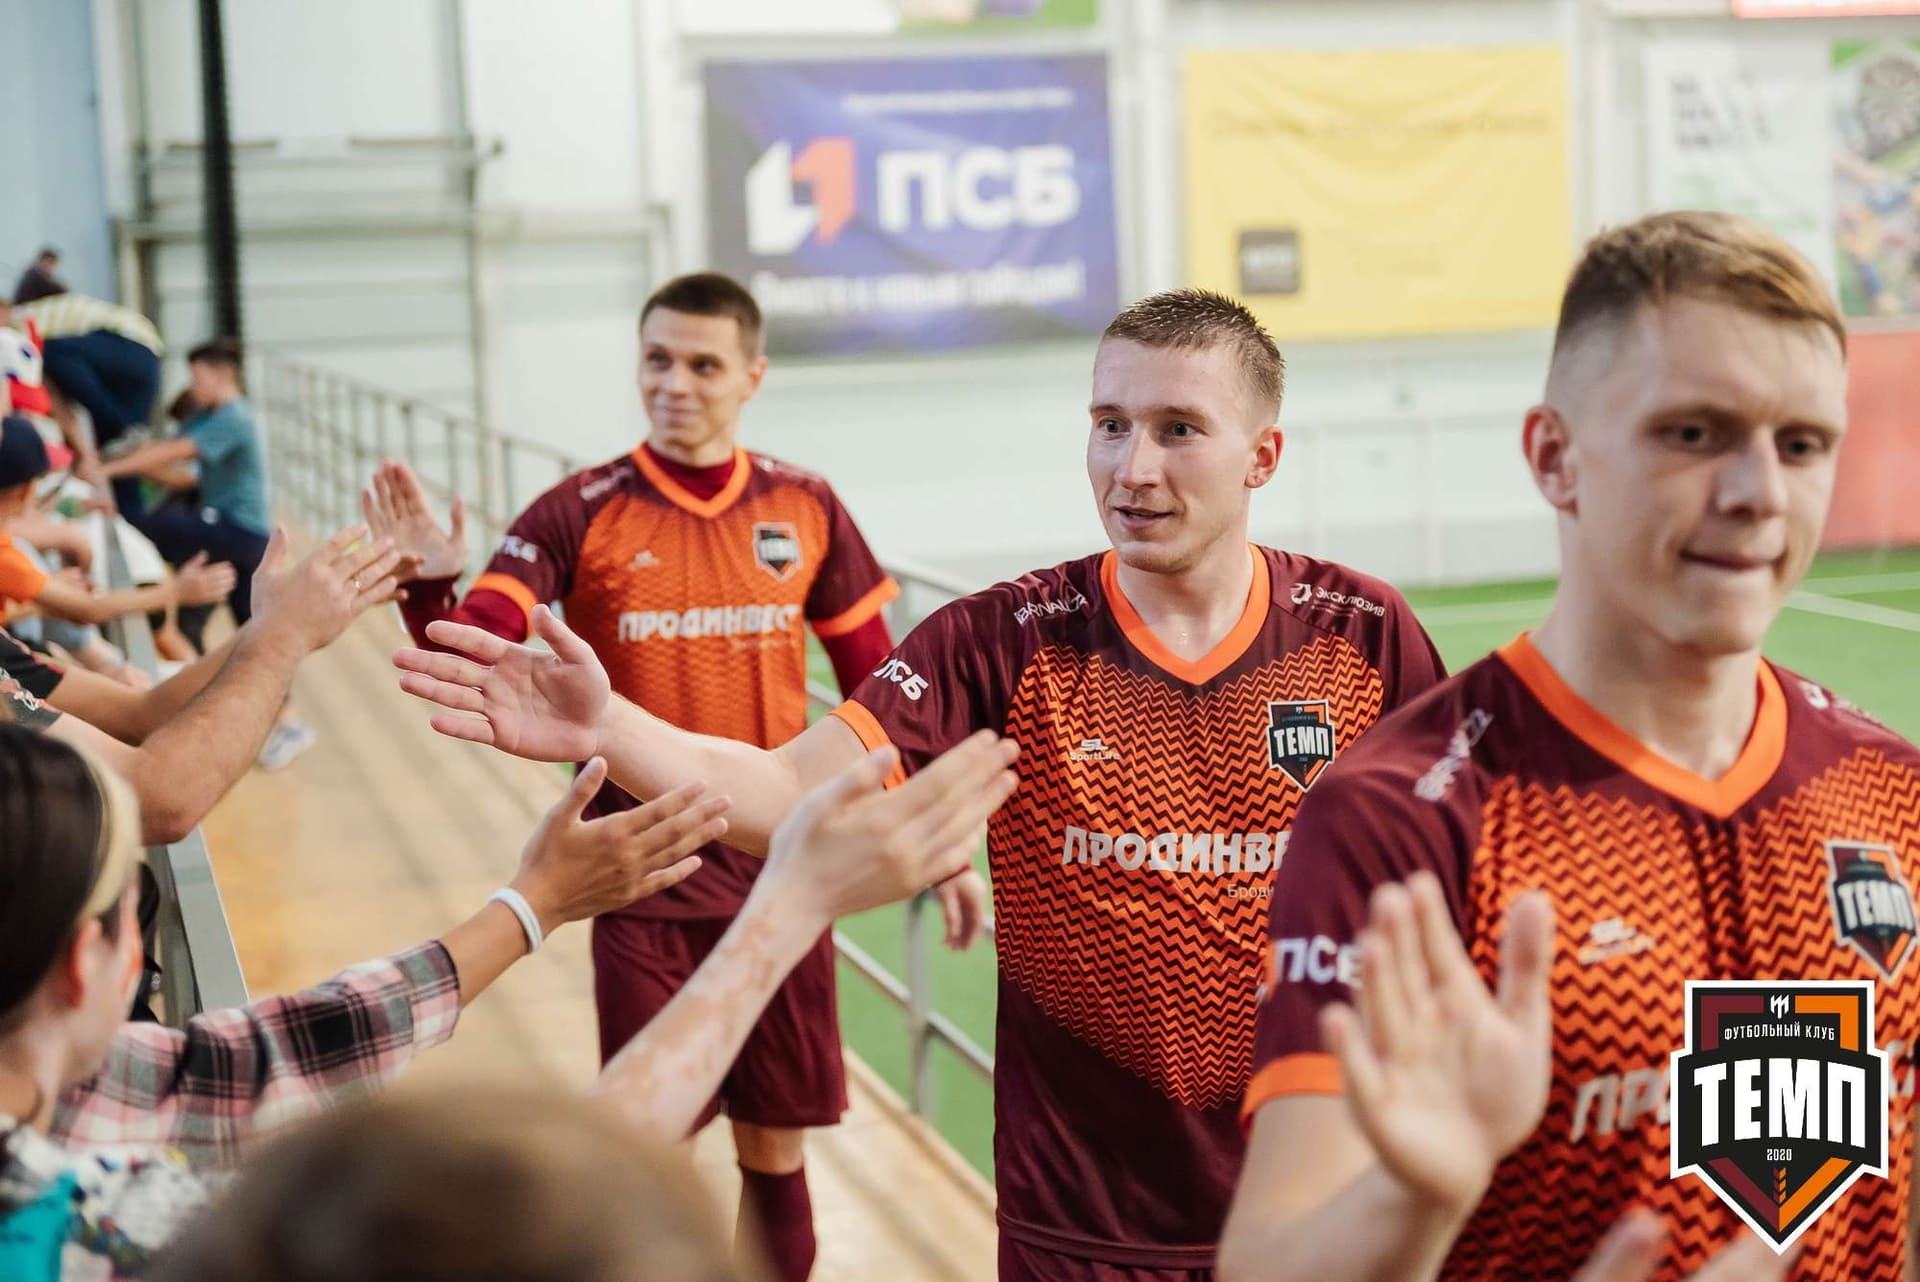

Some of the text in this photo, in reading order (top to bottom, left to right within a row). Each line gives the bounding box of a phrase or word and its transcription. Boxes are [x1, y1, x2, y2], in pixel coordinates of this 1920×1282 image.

[877, 144, 1082, 234] ПСБ
[1315, 586, 1386, 617] ЭКСКЛЮЗИВ
[872, 658, 929, 701] ПСБ
[1273, 725, 1331, 759] ТЕМП
[1837, 879, 1914, 931] ТЕМП
